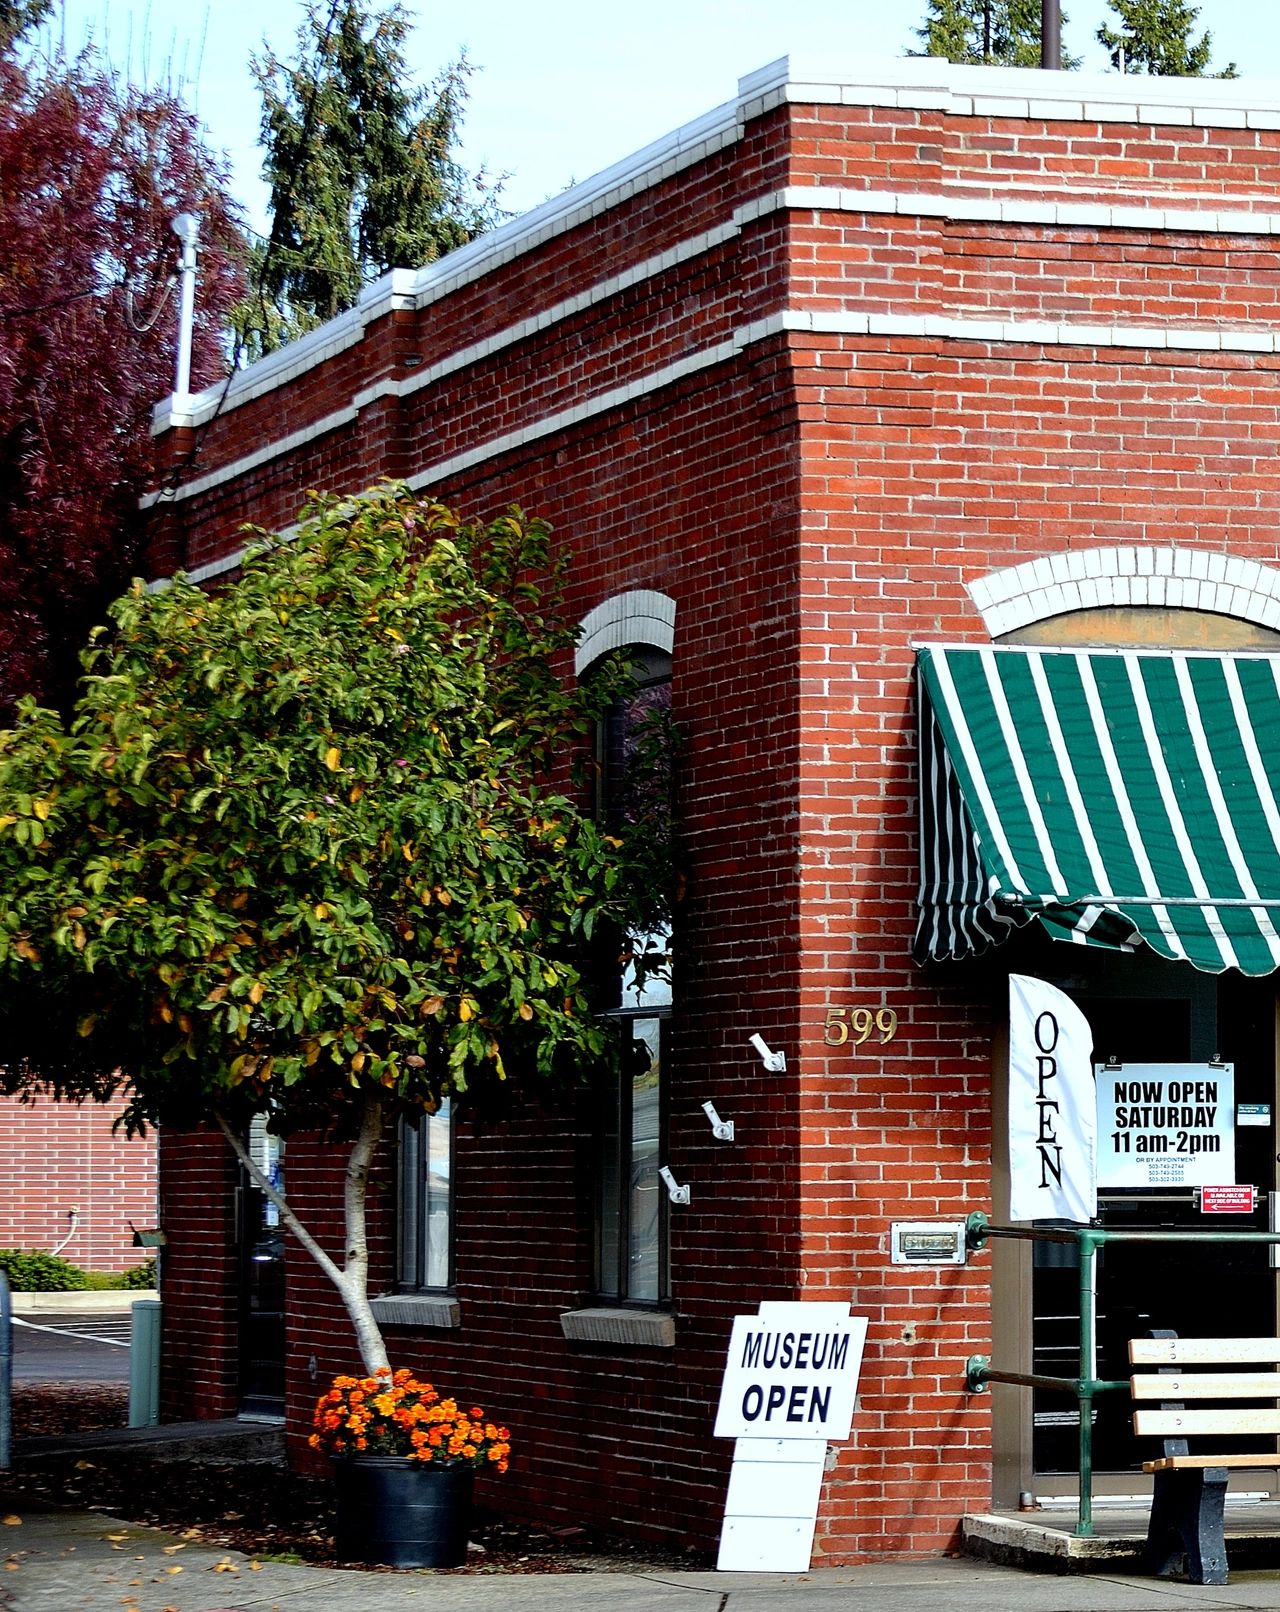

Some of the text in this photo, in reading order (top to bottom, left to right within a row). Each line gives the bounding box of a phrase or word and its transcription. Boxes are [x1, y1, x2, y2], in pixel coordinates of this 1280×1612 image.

[824, 1008, 898, 1046] 599
[1034, 1011, 1063, 1191] OPEN
[1114, 1082, 1218, 1104] NOW OPEN
[1115, 1106, 1217, 1128] SATURDAY
[1111, 1131, 1220, 1154] 11 am-2pm
[740, 1332, 850, 1370] MUSEUM
[741, 1384, 832, 1423] OPEN
